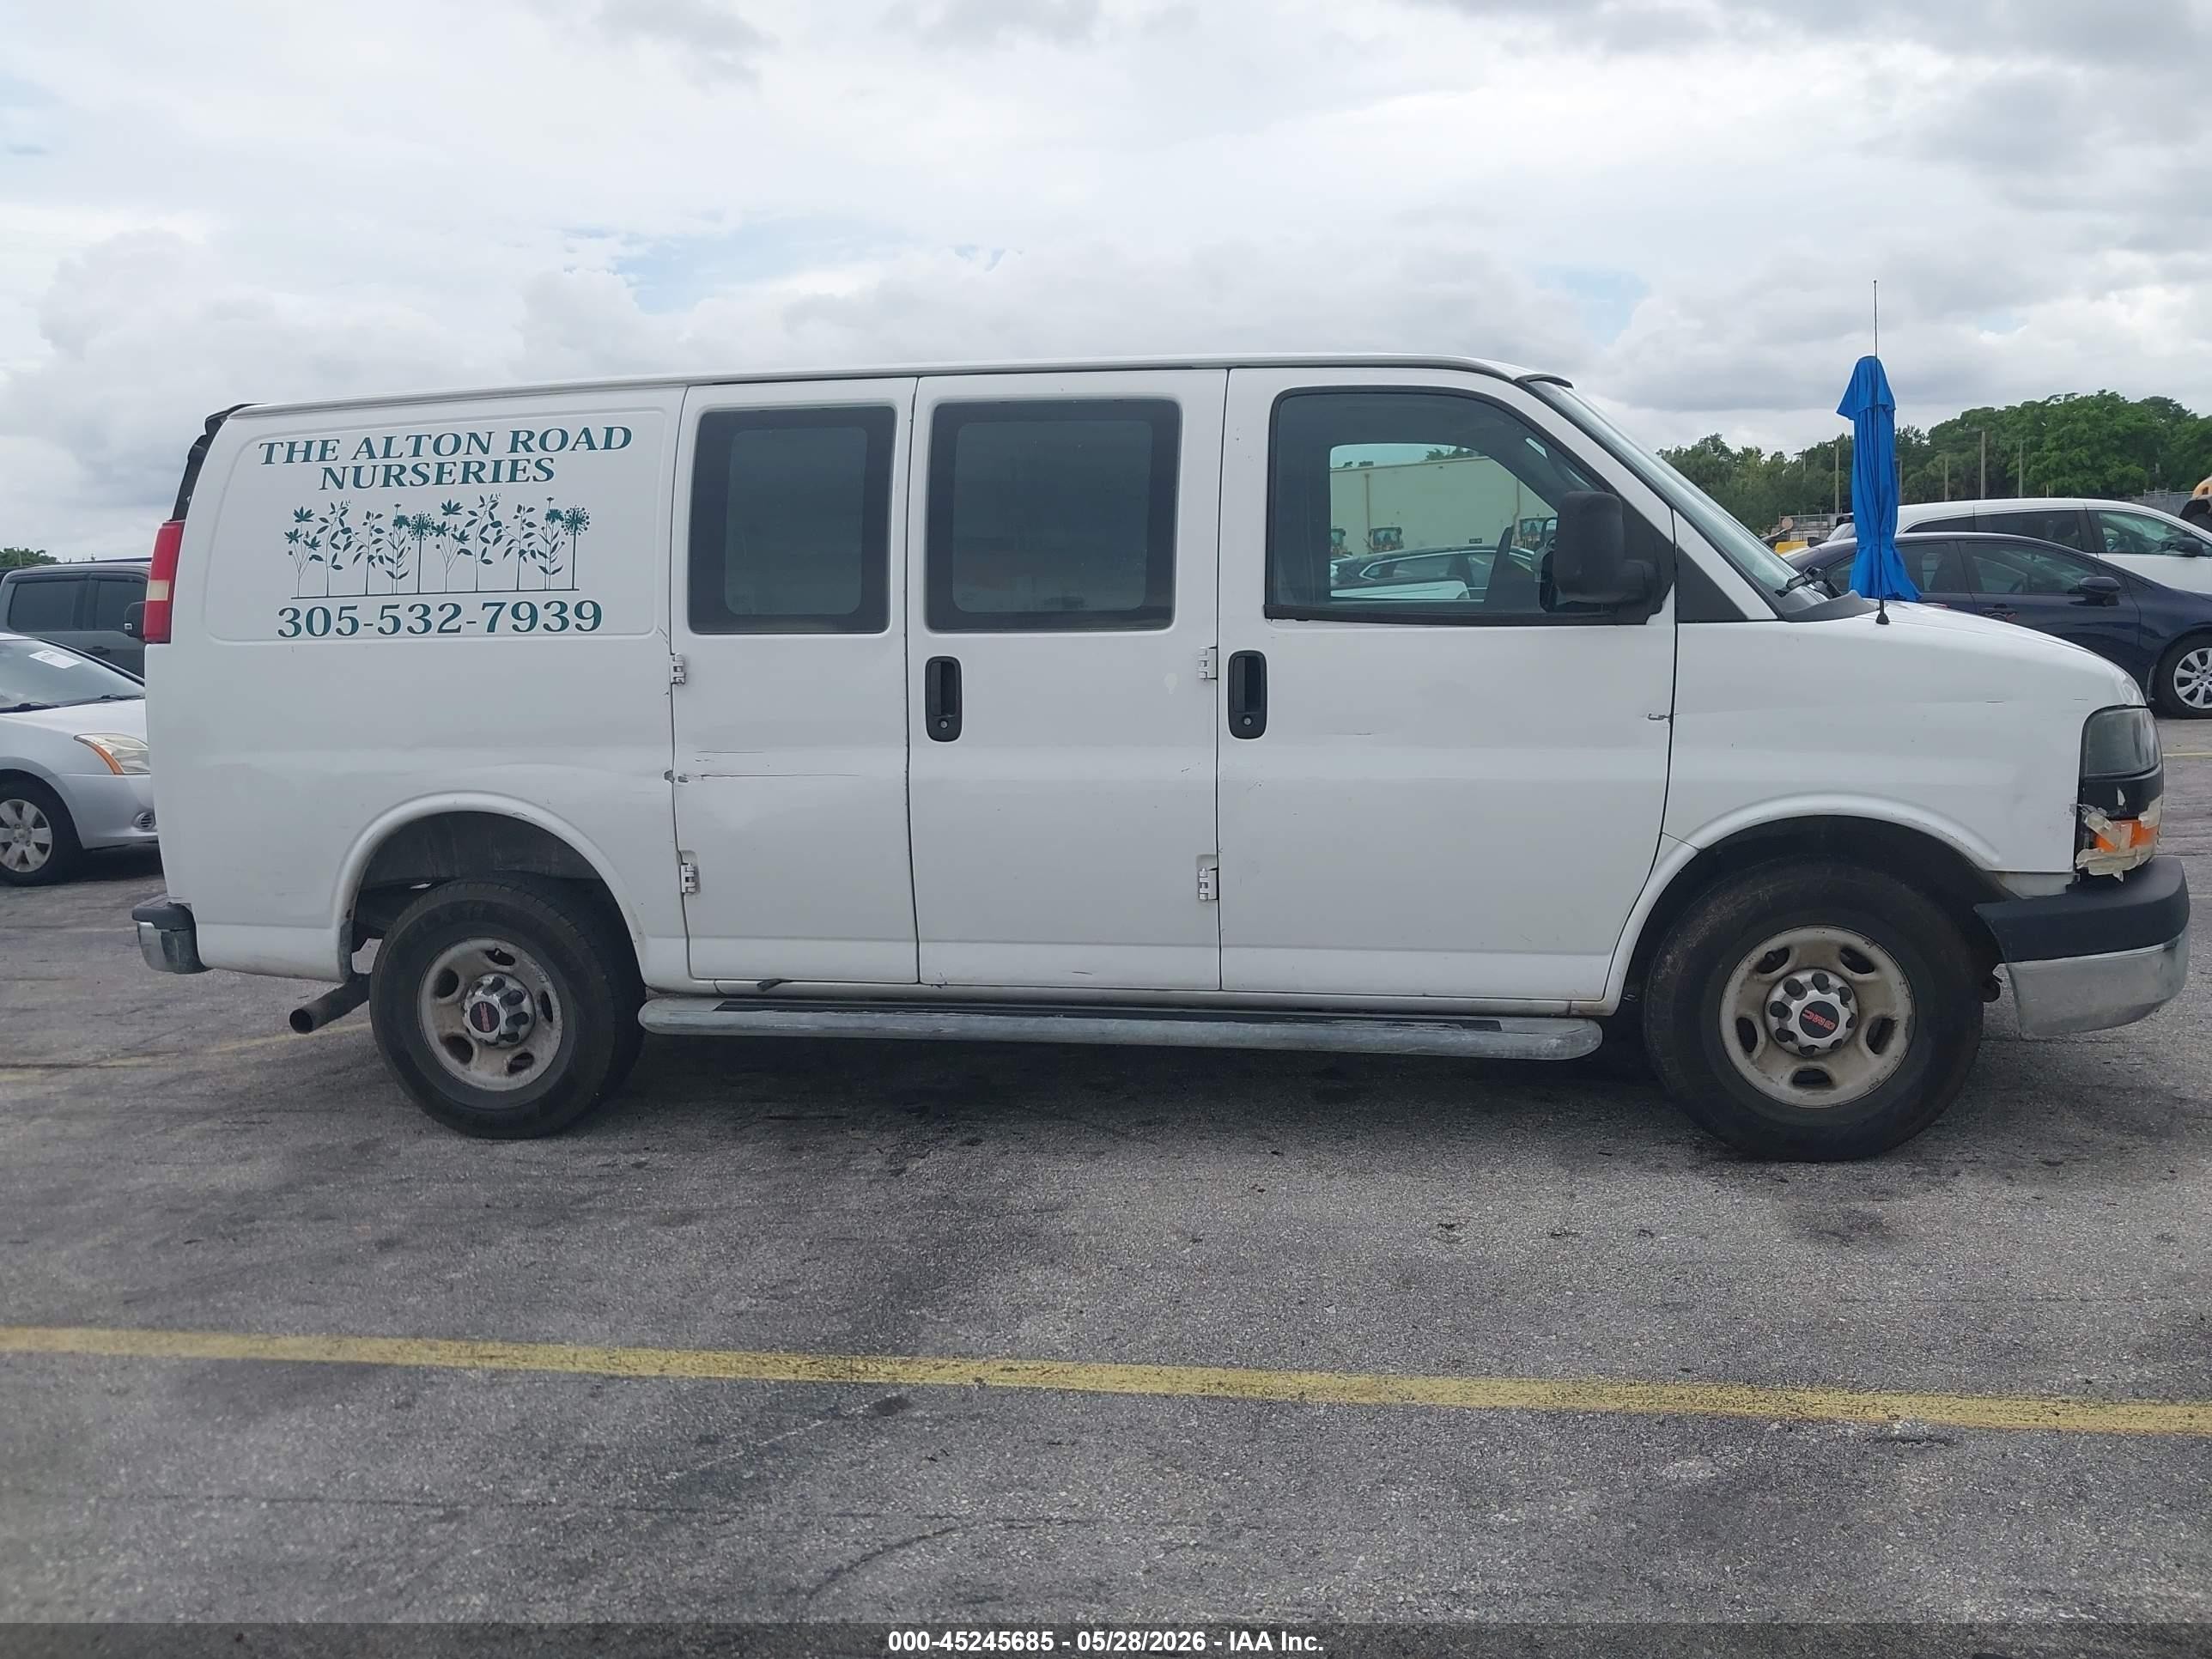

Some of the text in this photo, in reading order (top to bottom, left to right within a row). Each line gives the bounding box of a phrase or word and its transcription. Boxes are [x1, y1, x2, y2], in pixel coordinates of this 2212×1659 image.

[258, 426, 632, 465] THE ALTON ROAD
[319, 457, 555, 490] NURSERIES
[276, 600, 603, 638] 305-532-7939
[1802, 1009, 1836, 1030] GMC
